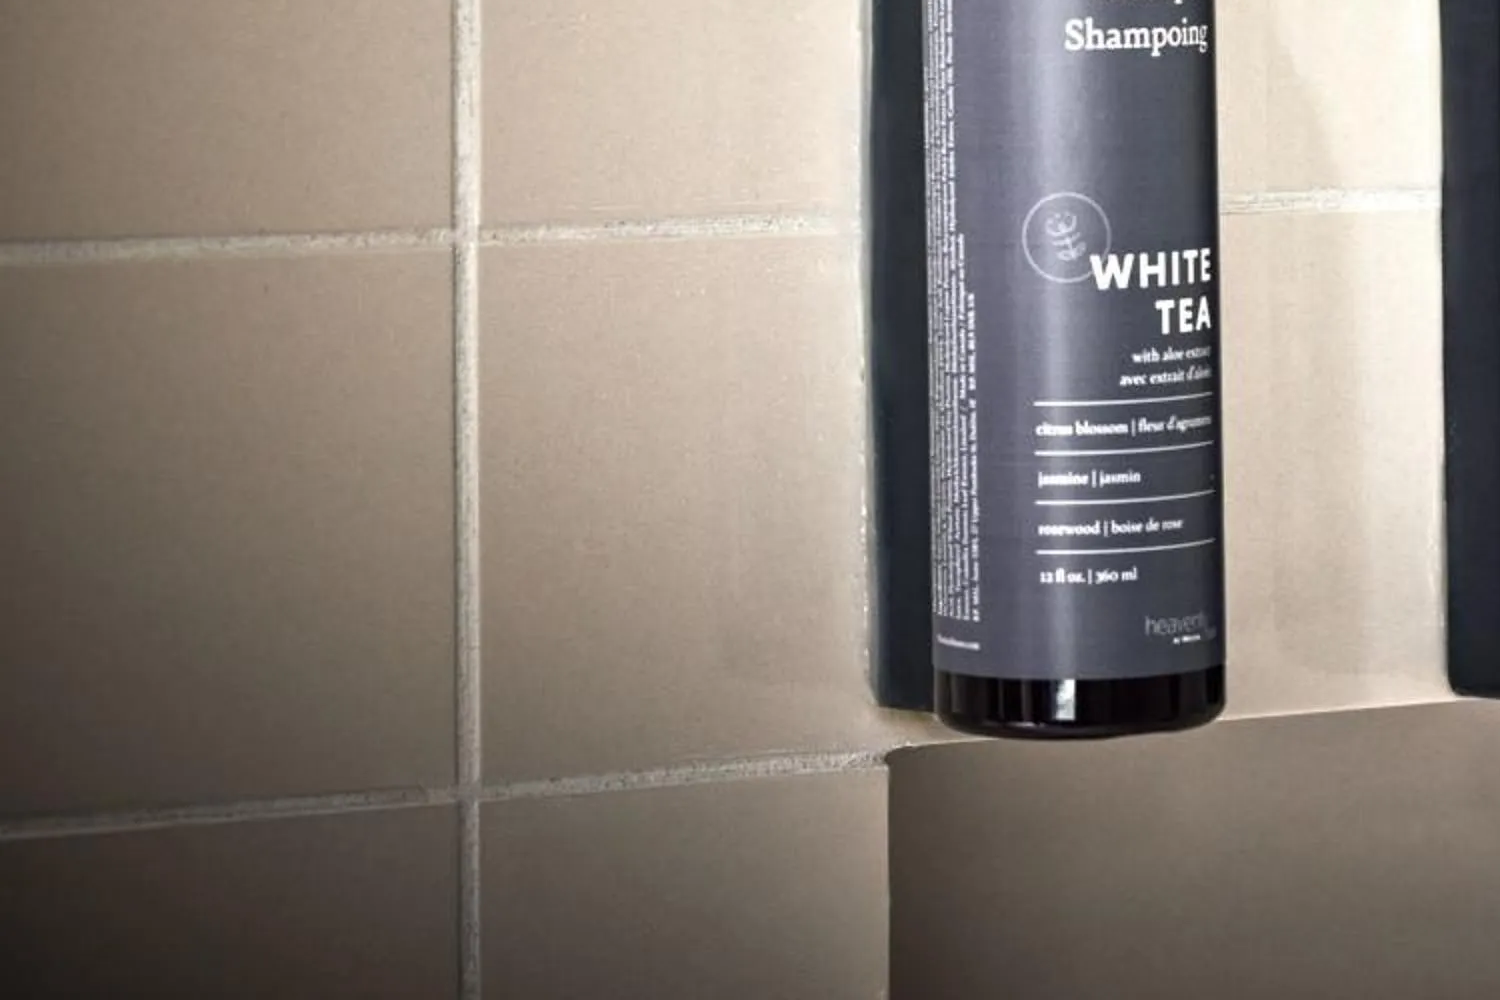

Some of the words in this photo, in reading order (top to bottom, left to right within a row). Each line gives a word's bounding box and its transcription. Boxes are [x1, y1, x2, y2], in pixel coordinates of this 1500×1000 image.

[1064, 17, 1208, 56] Shampoing
[1090, 248, 1211, 290] WHITE
[1155, 296, 1211, 335] TEA
[1035, 421, 1073, 437] citrus
[1075, 419, 1129, 436] blossom
[1038, 471, 1089, 488] jasmine
[1099, 469, 1141, 487] jasmin
[1038, 520, 1100, 536] rosewood
[1145, 517, 1160, 532] de
[1121, 566, 1138, 581] ml
